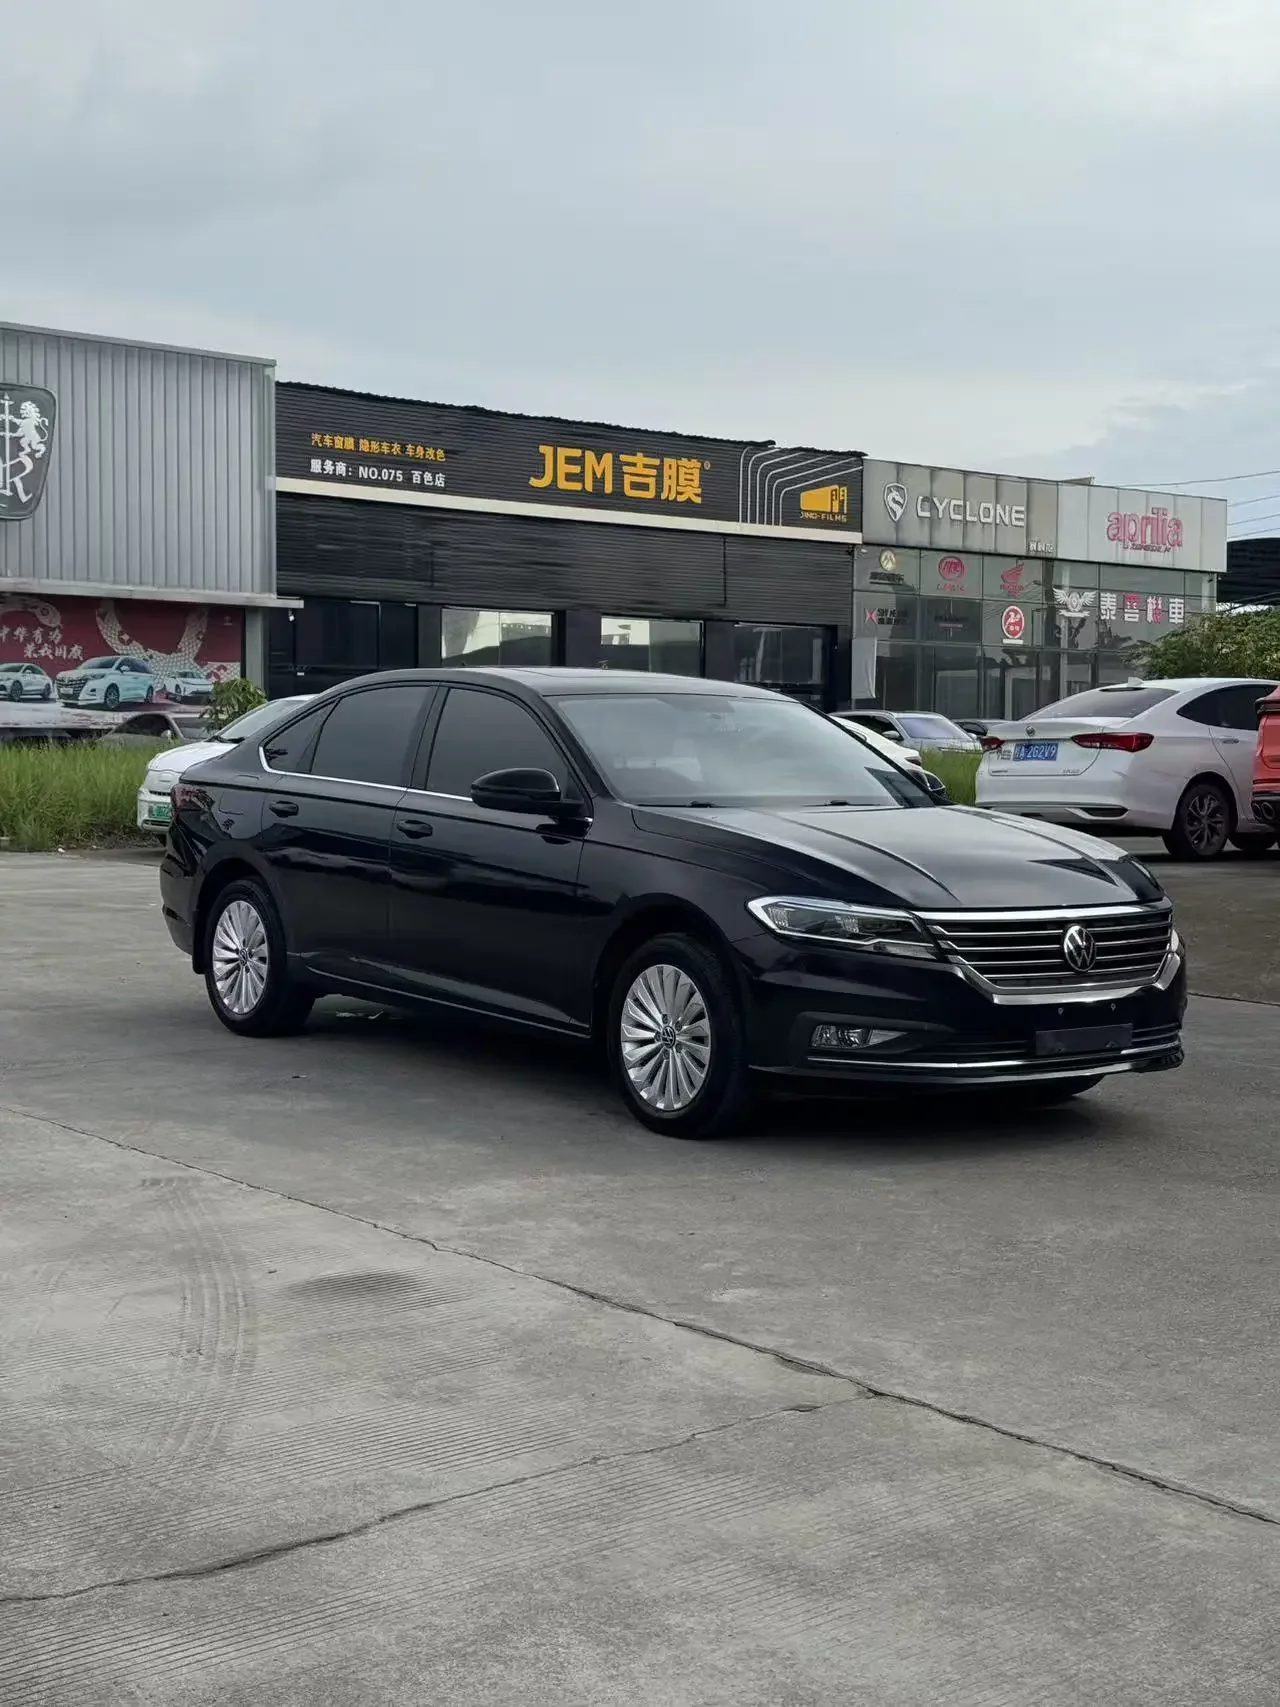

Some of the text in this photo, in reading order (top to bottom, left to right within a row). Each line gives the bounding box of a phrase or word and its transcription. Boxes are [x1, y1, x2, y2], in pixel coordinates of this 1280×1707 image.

[311, 433, 446, 462] 汽车窗膜 隐形车衣 车身改色
[358, 466, 403, 482] NO.075
[411, 470, 446, 488] 百色店
[528, 444, 703, 505] JEM 吉膜
[917, 496, 1025, 527] CYCLONE
[1106, 507, 1184, 551] aprilia
